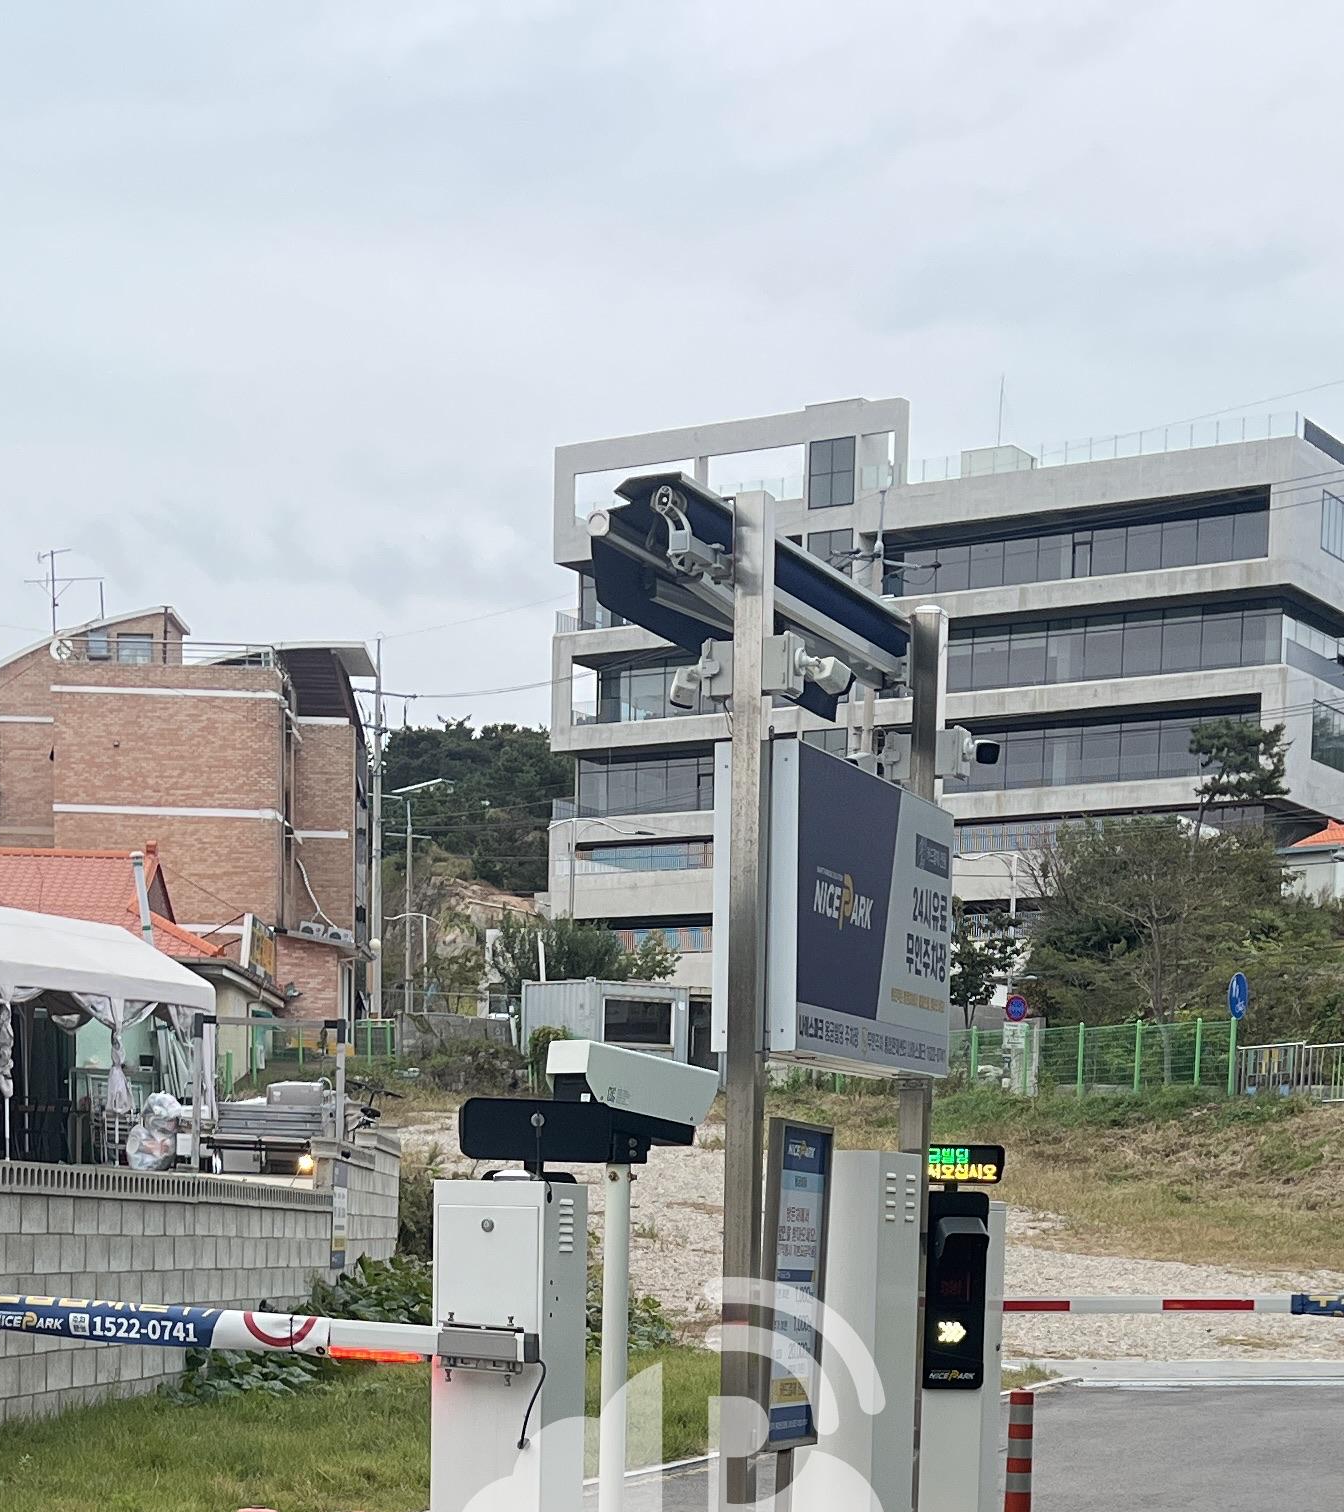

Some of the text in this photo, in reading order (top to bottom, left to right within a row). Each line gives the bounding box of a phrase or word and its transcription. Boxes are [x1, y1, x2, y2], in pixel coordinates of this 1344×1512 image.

[813, 872, 874, 931] NICEPARK
[912, 886, 948, 933] 24시유료
[906, 932, 947, 983] 무인주차장
[92, 1315, 198, 1342] 1522-0741
